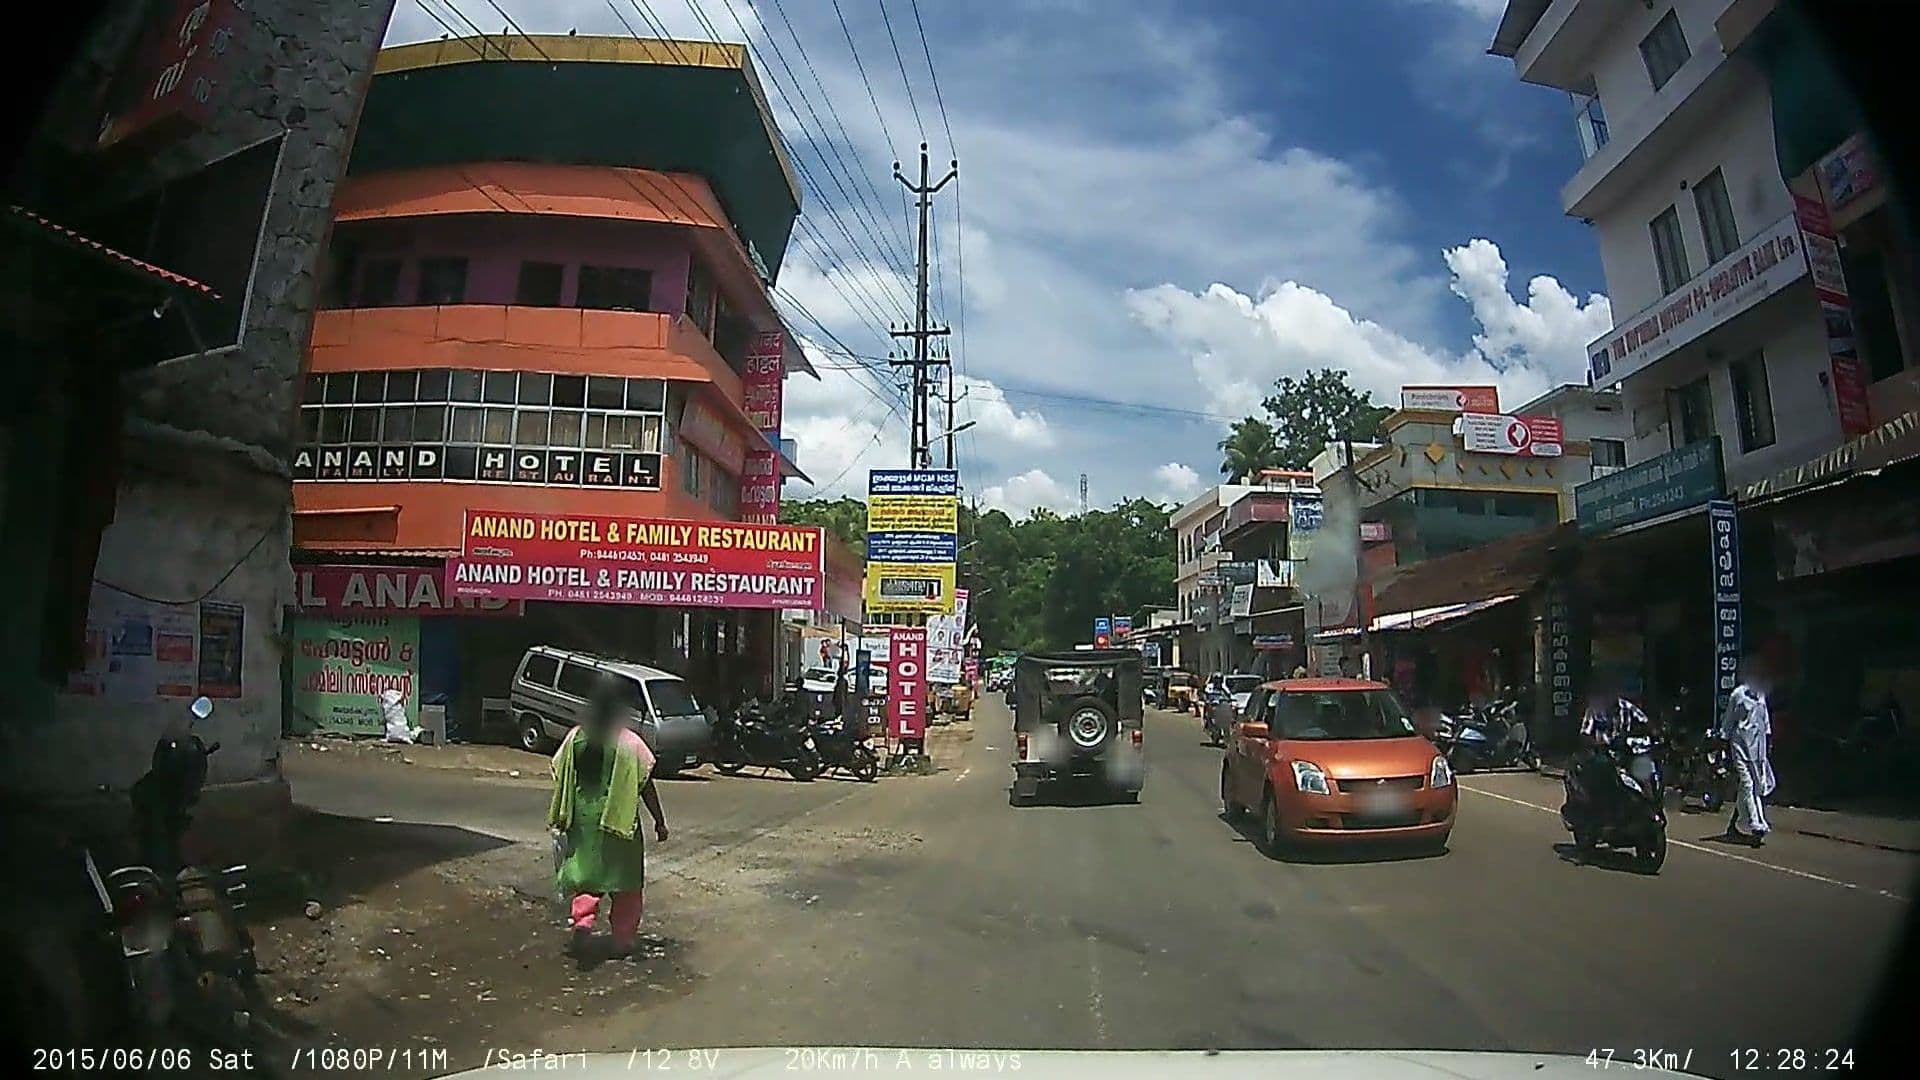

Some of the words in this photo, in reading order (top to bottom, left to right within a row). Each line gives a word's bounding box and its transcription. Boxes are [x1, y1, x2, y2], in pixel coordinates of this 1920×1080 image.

[295, 450, 437, 467] ANAND
[485, 452, 650, 474] HOTEL
[322, 468, 405, 477] FAMILY
[482, 469, 654, 484] RESTAURANT
[470, 516, 535, 539] ANAND
[540, 519, 601, 543] HOTEL
[606, 522, 620, 543] &
[626, 523, 693, 546] FAMILY
[697, 527, 817, 553] RESTAURANT
[454, 563, 522, 584] ANAND
[527, 566, 591, 587] HOTEL
[597, 569, 611, 588] &
[617, 570, 686, 591] FAMILY
[691, 571, 816, 596] RESTAURANT
[898, 642, 918, 735] HOTEL
